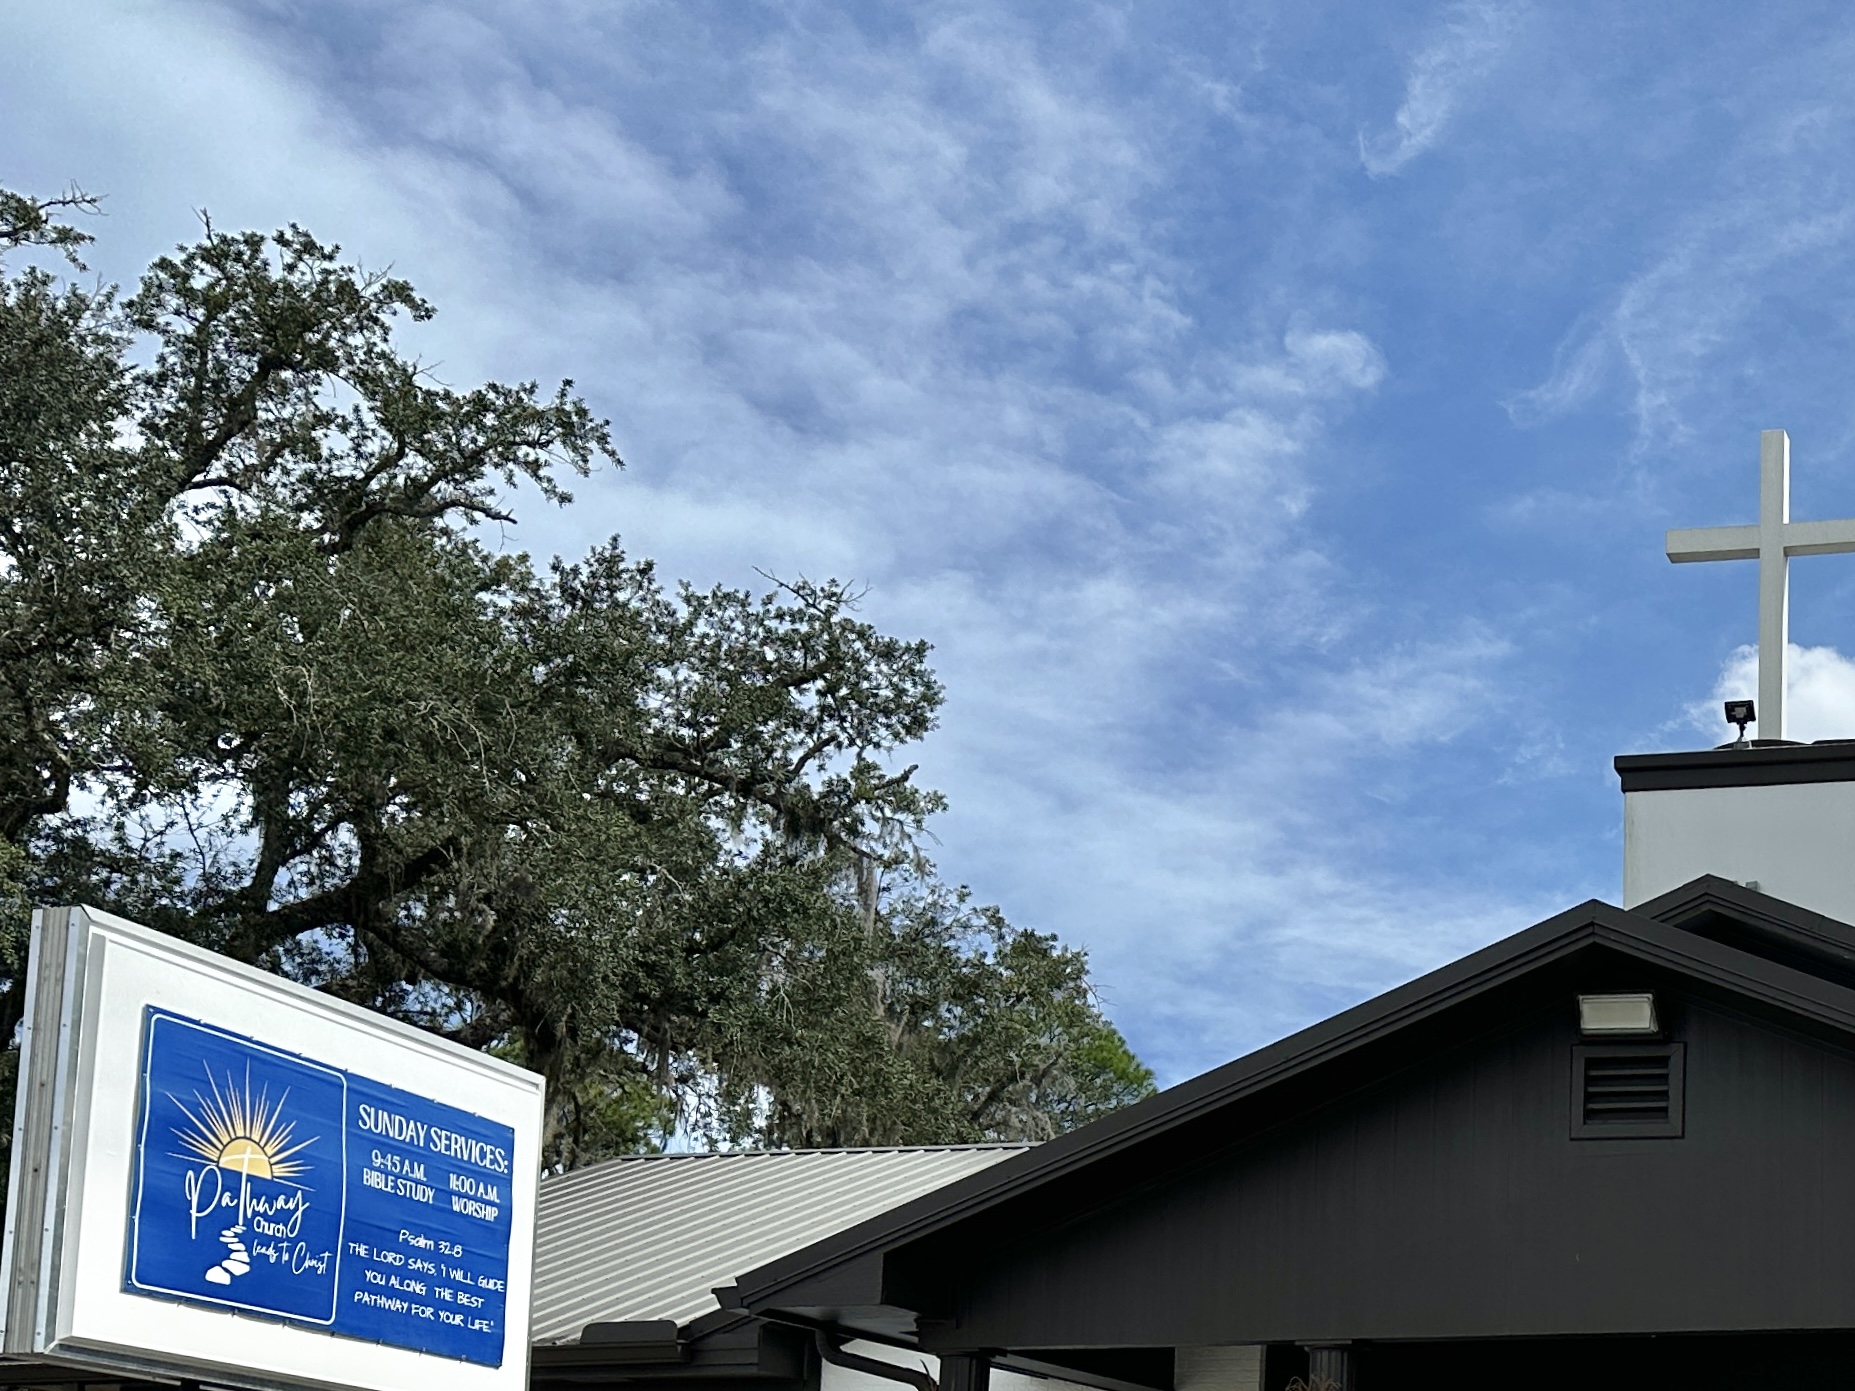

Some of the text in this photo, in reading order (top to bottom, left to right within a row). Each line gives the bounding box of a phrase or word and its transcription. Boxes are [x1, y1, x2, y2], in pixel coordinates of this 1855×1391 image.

[358, 1104, 509, 1174] SUNDAY SERVICES:
[371, 1149, 427, 1181] 9:45 A.M.
[185, 1165, 310, 1240] Pathway
[363, 1168, 435, 1204] BIBLE STUDY
[449, 1173, 500, 1203] 11:00 A.M.
[451, 1195, 499, 1222] WORSHIP
[253, 1216, 287, 1239] Church
[399, 1229, 435, 1251] Psalm
[292, 1242, 333, 1275] Christ
[348, 1242, 370, 1258] THE
[373, 1247, 404, 1266] LORD
[449, 1267, 475, 1285] WILL
[477, 1275, 505, 1292] GUIDE
[364, 1269, 485, 1308] YOU ALONG THE BEST
[354, 1291, 408, 1314] PATHWAY
[411, 1303, 435, 1320] FOR
[438, 1310, 464, 1327] YOUR
